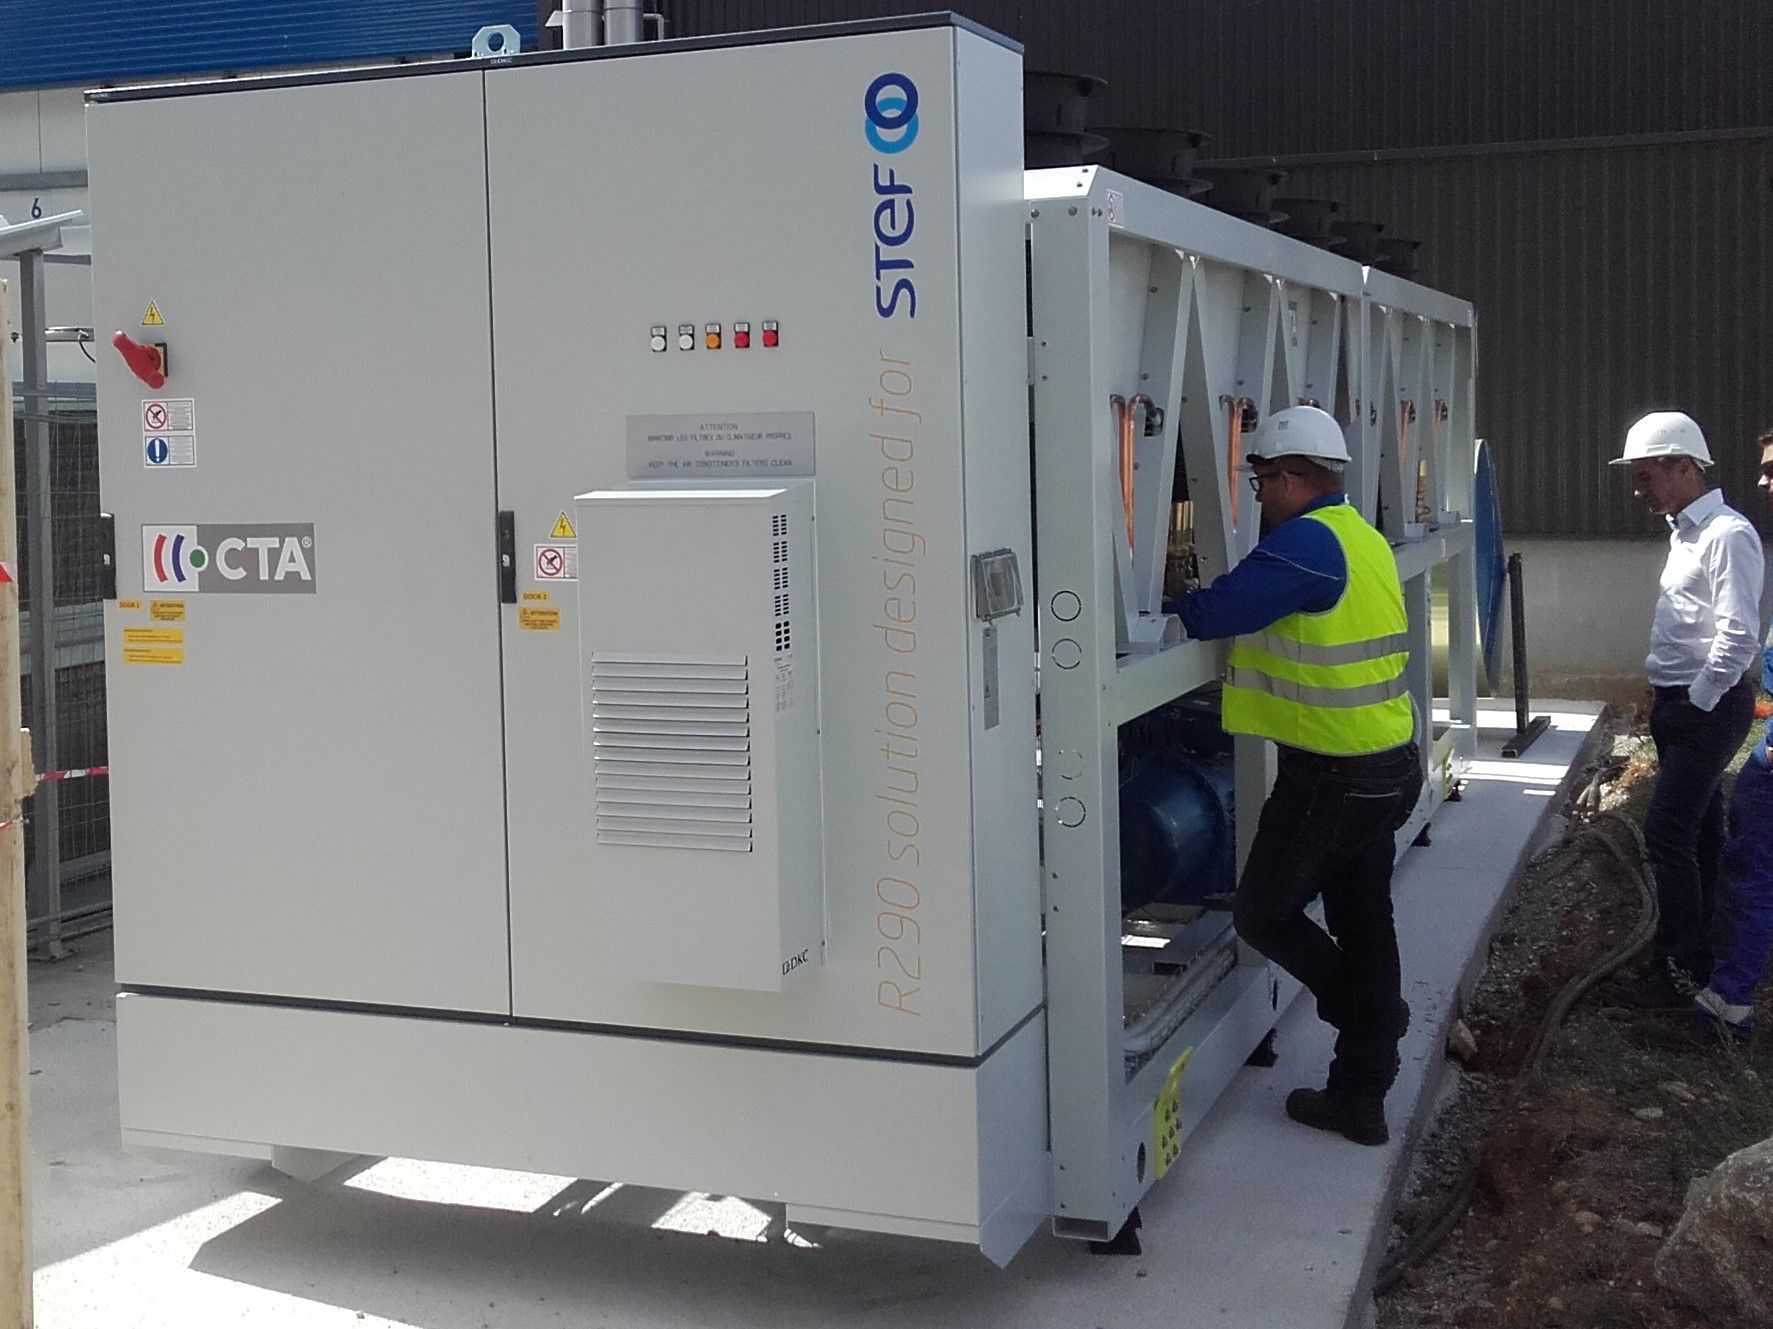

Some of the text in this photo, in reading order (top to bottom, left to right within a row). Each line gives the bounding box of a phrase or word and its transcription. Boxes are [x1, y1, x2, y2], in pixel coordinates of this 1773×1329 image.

[31, 197, 42, 219] 6
[868, 348, 922, 424] for
[699, 423, 739, 431] ATTENTION
[771, 459, 793, 467] CLEAN
[869, 434, 926, 654] designed
[874, 670, 920, 867] solution
[876, 877, 922, 1017] R290
